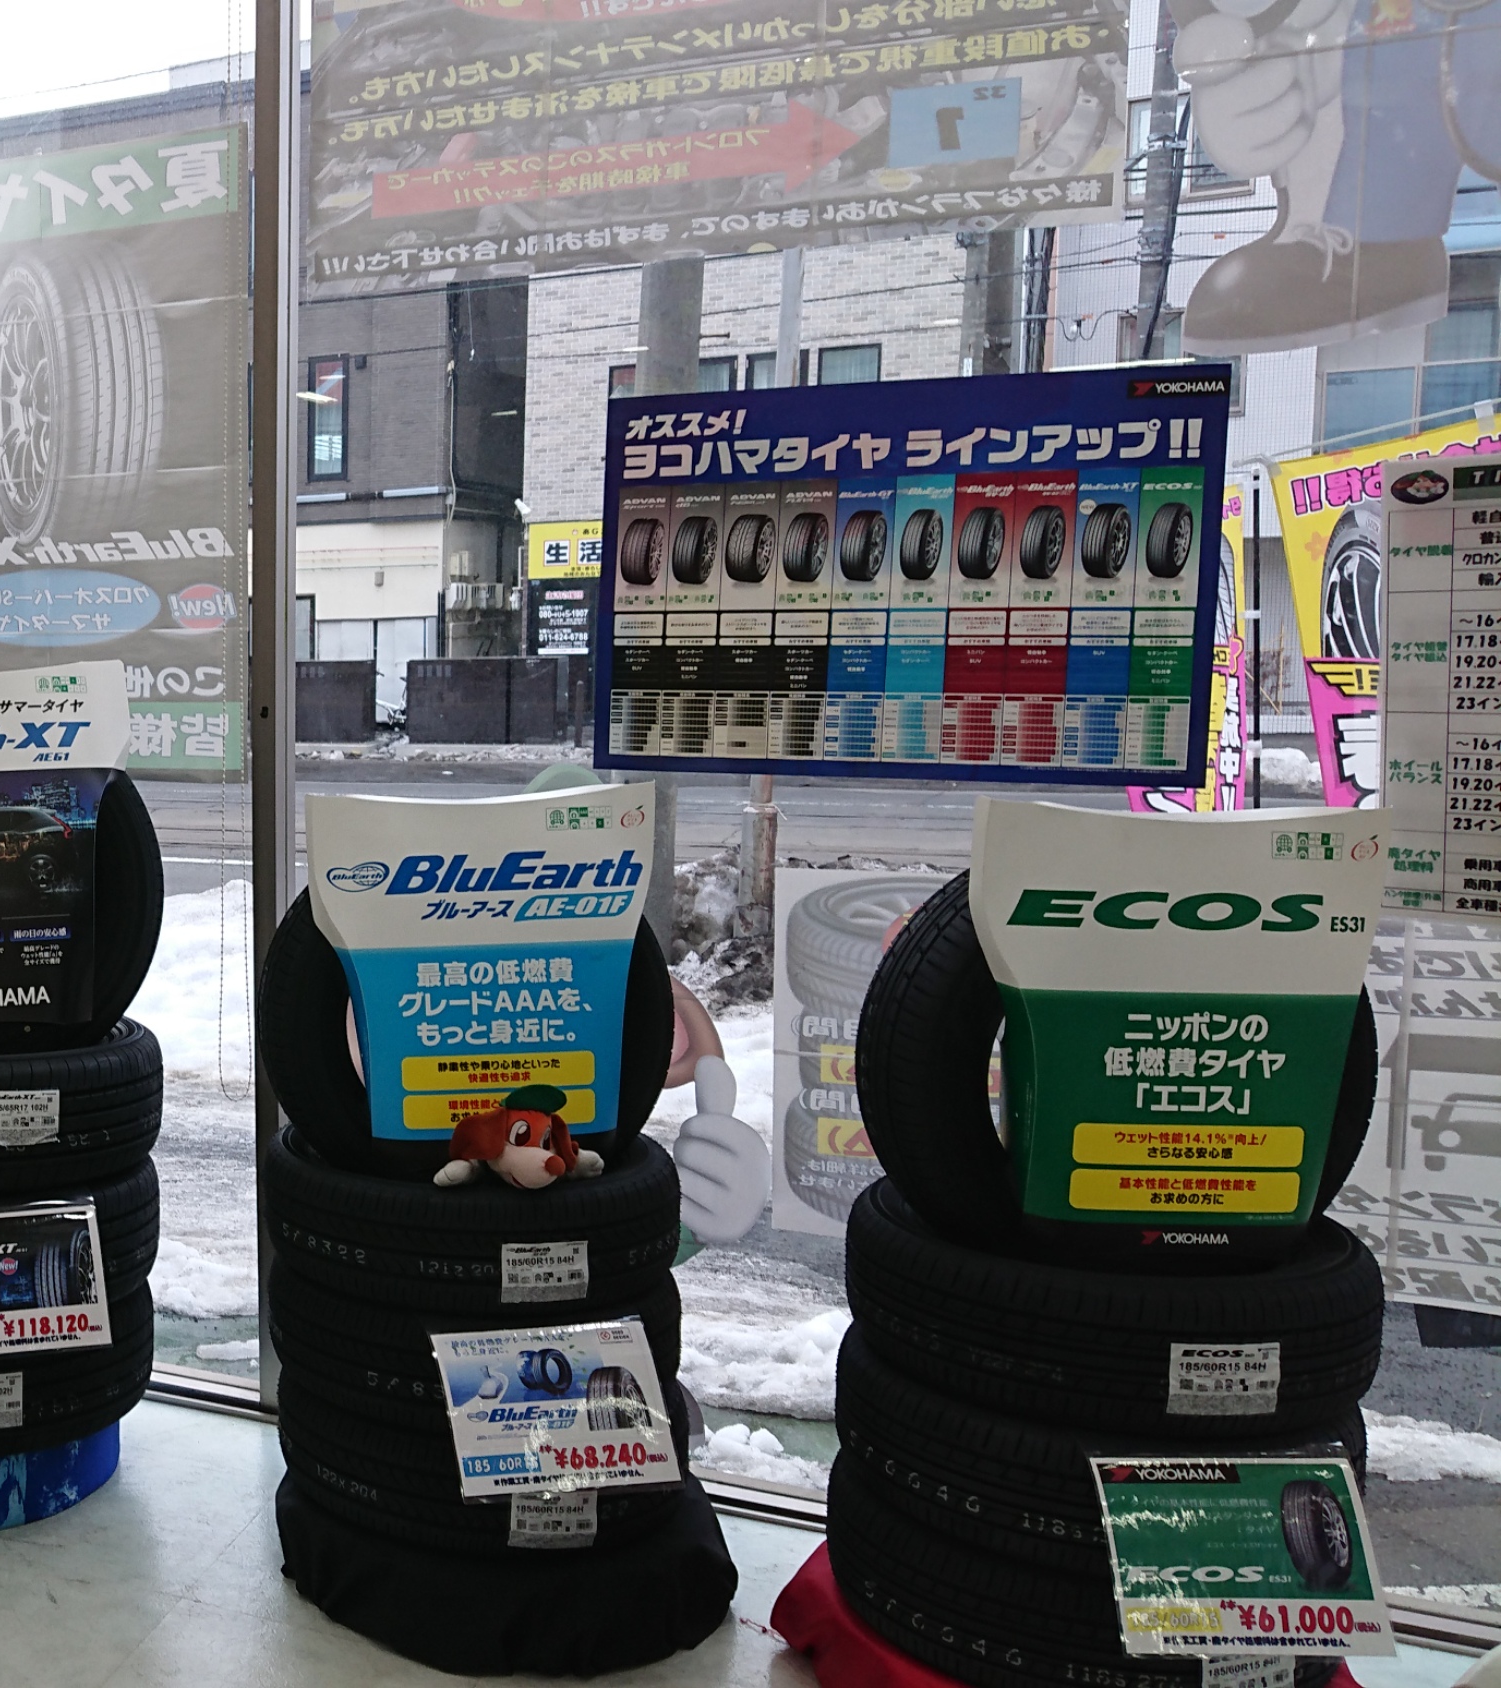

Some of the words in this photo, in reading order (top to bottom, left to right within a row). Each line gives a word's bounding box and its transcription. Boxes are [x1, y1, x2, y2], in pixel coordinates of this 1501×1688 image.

[1155, 379, 1225, 395] YOKOHAMA
[625, 409, 747, 439] オススメ!
[622, 433, 891, 481] ヨコハマタイヤ
[905, 417, 1203, 468] ラインアップ!!
[1143, 482, 1193, 490] ECOS
[1456, 635, 1501, 647] 17.18
[1453, 757, 1501, 771] 17.18
[385, 849, 644, 896] BluEarth
[421, 900, 514, 921] ブルーアース
[525, 895, 628, 917] AE-01F
[1006, 889, 1324, 932] ECOS
[1330, 916, 1365, 933] ES31
[416, 958, 573, 988] 最高の低燃費
[398, 988, 593, 1017] グレードAAAを、
[416, 1019, 577, 1047] もっと身近に。
[1124, 1013, 1268, 1042] ニッポンの
[437, 1058, 561, 1074] 静粛性や乗り心地といった
[1104, 1047, 1286, 1079] 低燃費タイヤ
[1136, 1084, 1251, 1115] 「エコス」
[1147, 1145, 1233, 1160] さらなる安心感
[1119, 1177, 1257, 1192] 基本性能と低燃費性能を
[1150, 1191, 1224, 1205] お求めの方に
[1162, 1232, 1229, 1245] YOKOHAMA
[506, 1256, 556, 1267] 185/60R15
[557, 1254, 575, 1265] 84H
[1181, 1349, 1244, 1358] ECOS
[1179, 1361, 1242, 1373] 185/60R15
[1244, 1361, 1267, 1372] 84H
[1135, 1467, 1226, 1480] YOKOHAMA
[1127, 1566, 1265, 1583] ECOS
